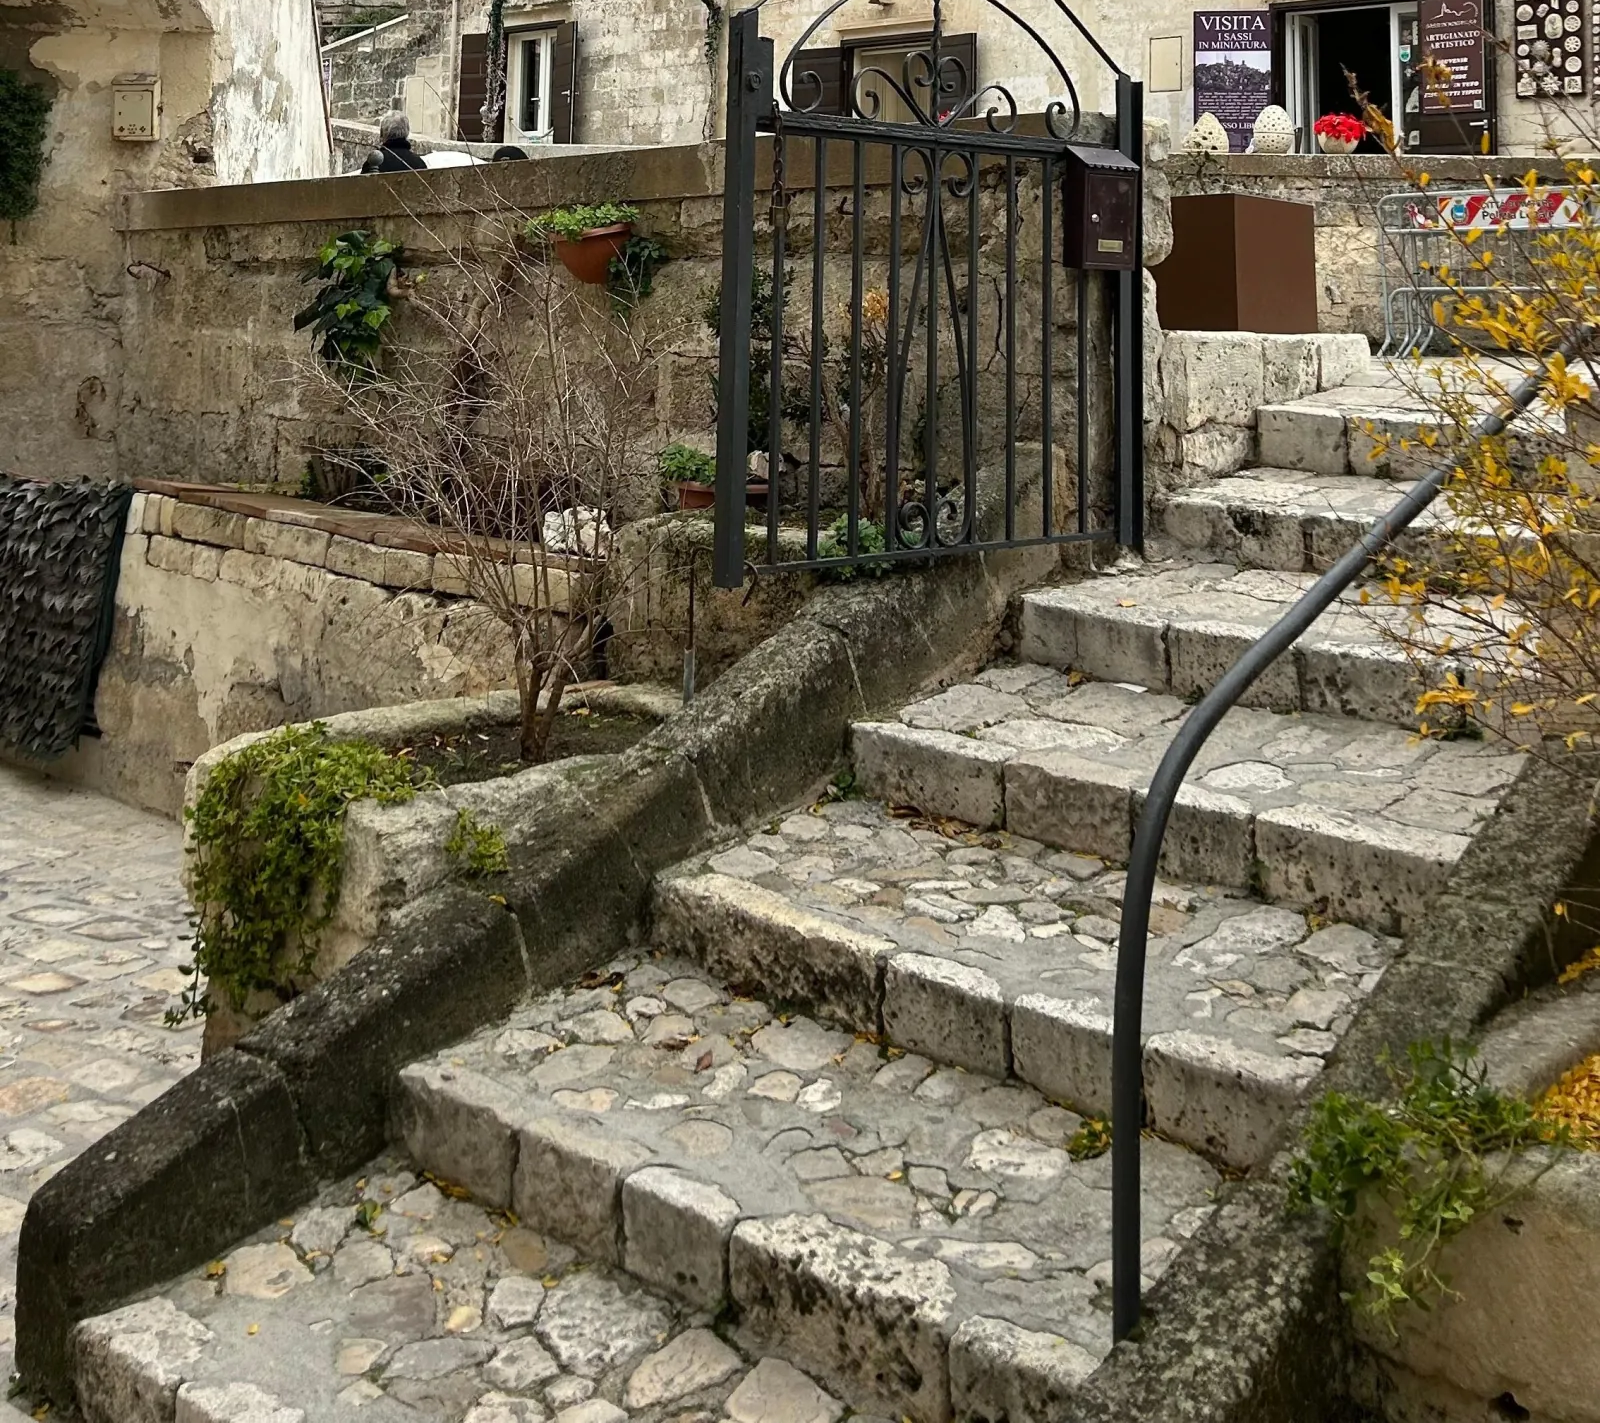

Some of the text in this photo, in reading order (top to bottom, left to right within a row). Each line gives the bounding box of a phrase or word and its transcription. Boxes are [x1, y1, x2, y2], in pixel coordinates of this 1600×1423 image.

[1200, 15, 1266, 31] VISITA
[1218, 32, 1252, 41] I SASSI
[1425, 30, 1481, 42] ARTIGIANATO
[1199, 41, 1268, 49] IN MINIATURA
[1430, 39, 1475, 50] ARTISTICO
